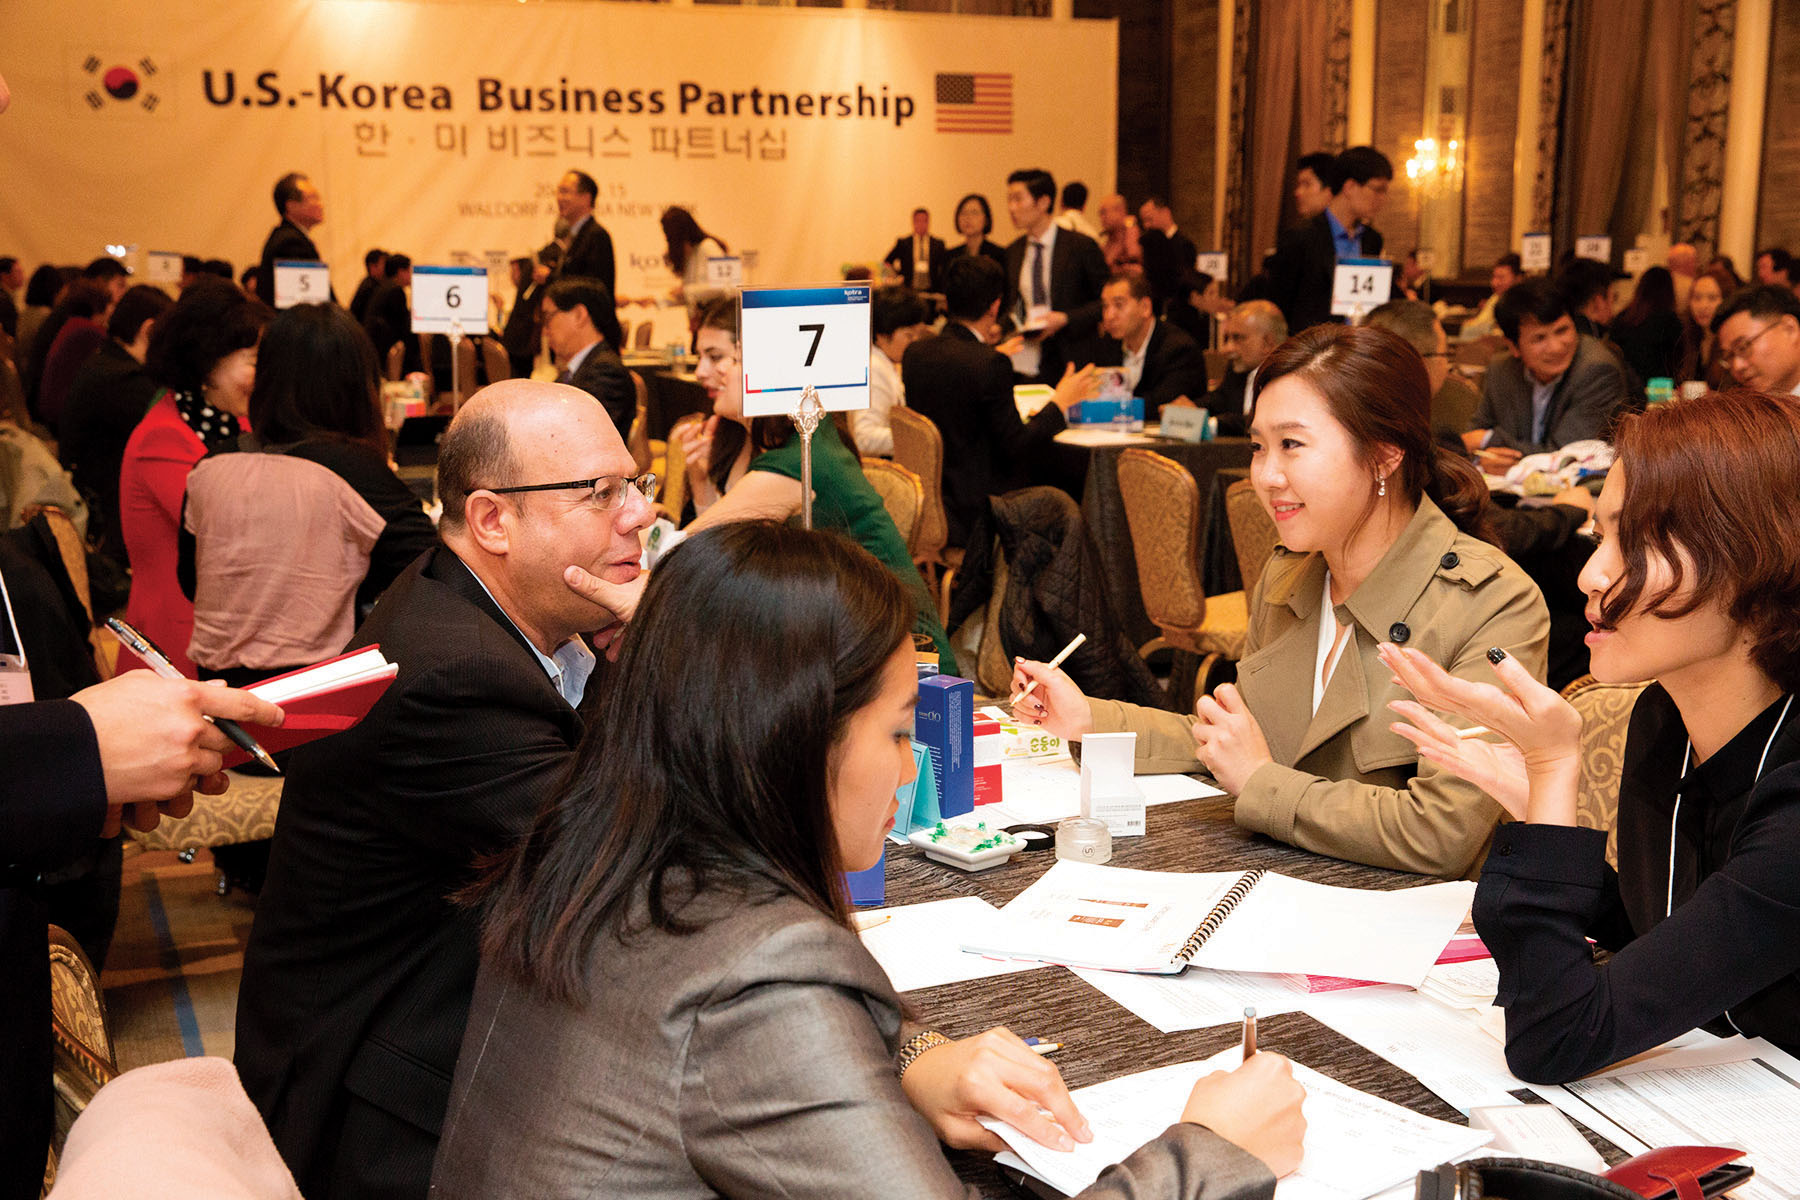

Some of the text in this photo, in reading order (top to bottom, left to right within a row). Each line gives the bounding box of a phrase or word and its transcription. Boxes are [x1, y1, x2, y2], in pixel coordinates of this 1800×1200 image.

[203, 69, 915, 127] U.S.-Korea Business Partnership
[354, 121, 391, 158] 한
[487, 123, 631, 158] 비즈니스
[650, 126, 787, 160] 파트너십
[299, 274, 310, 292] 5
[1350, 275, 1373, 294] 14
[446, 285, 461, 309] 6
[798, 323, 825, 368] 7
[1030, 735, 1060, 753] 순둥이
